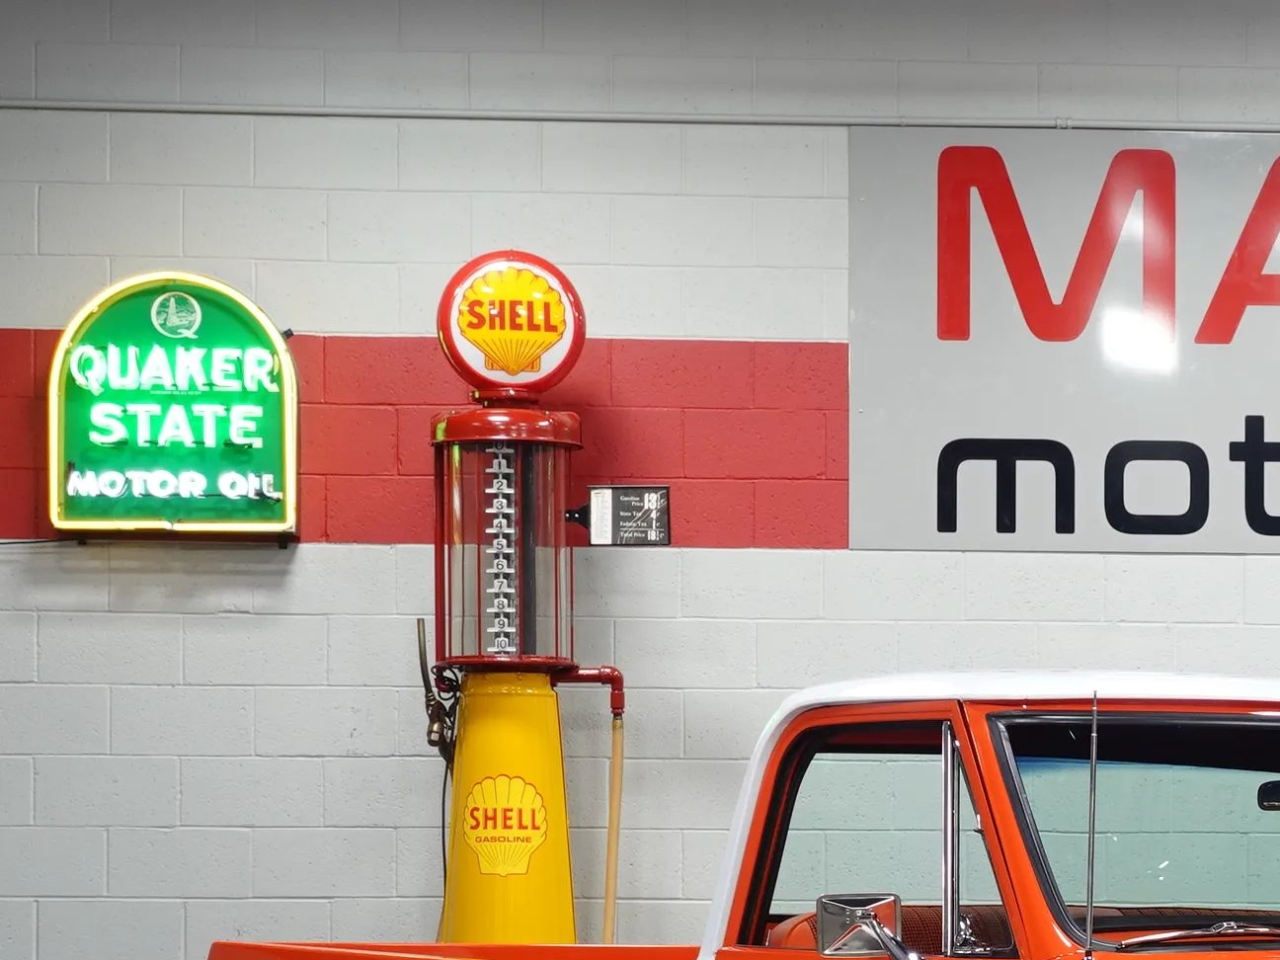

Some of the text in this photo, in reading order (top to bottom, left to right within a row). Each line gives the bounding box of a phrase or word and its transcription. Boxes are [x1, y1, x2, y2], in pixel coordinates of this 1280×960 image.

[466, 299, 559, 333] SHELL
[69, 340, 280, 397] QUAKER
[89, 402, 264, 449] STATE
[67, 469, 284, 500] MOTOR OIL
[496, 480, 504, 491] 2
[496, 500, 504, 510] 3
[495, 520, 503, 530] 4
[496, 540, 504, 550] 5
[496, 560, 504, 571] 6
[496, 580, 504, 590] 7
[496, 600, 505, 610] 8
[497, 619, 505, 629] 9
[496, 639, 507, 649] 10
[469, 806, 541, 831] SHELL
[475, 835, 533, 844] GASOLINE
